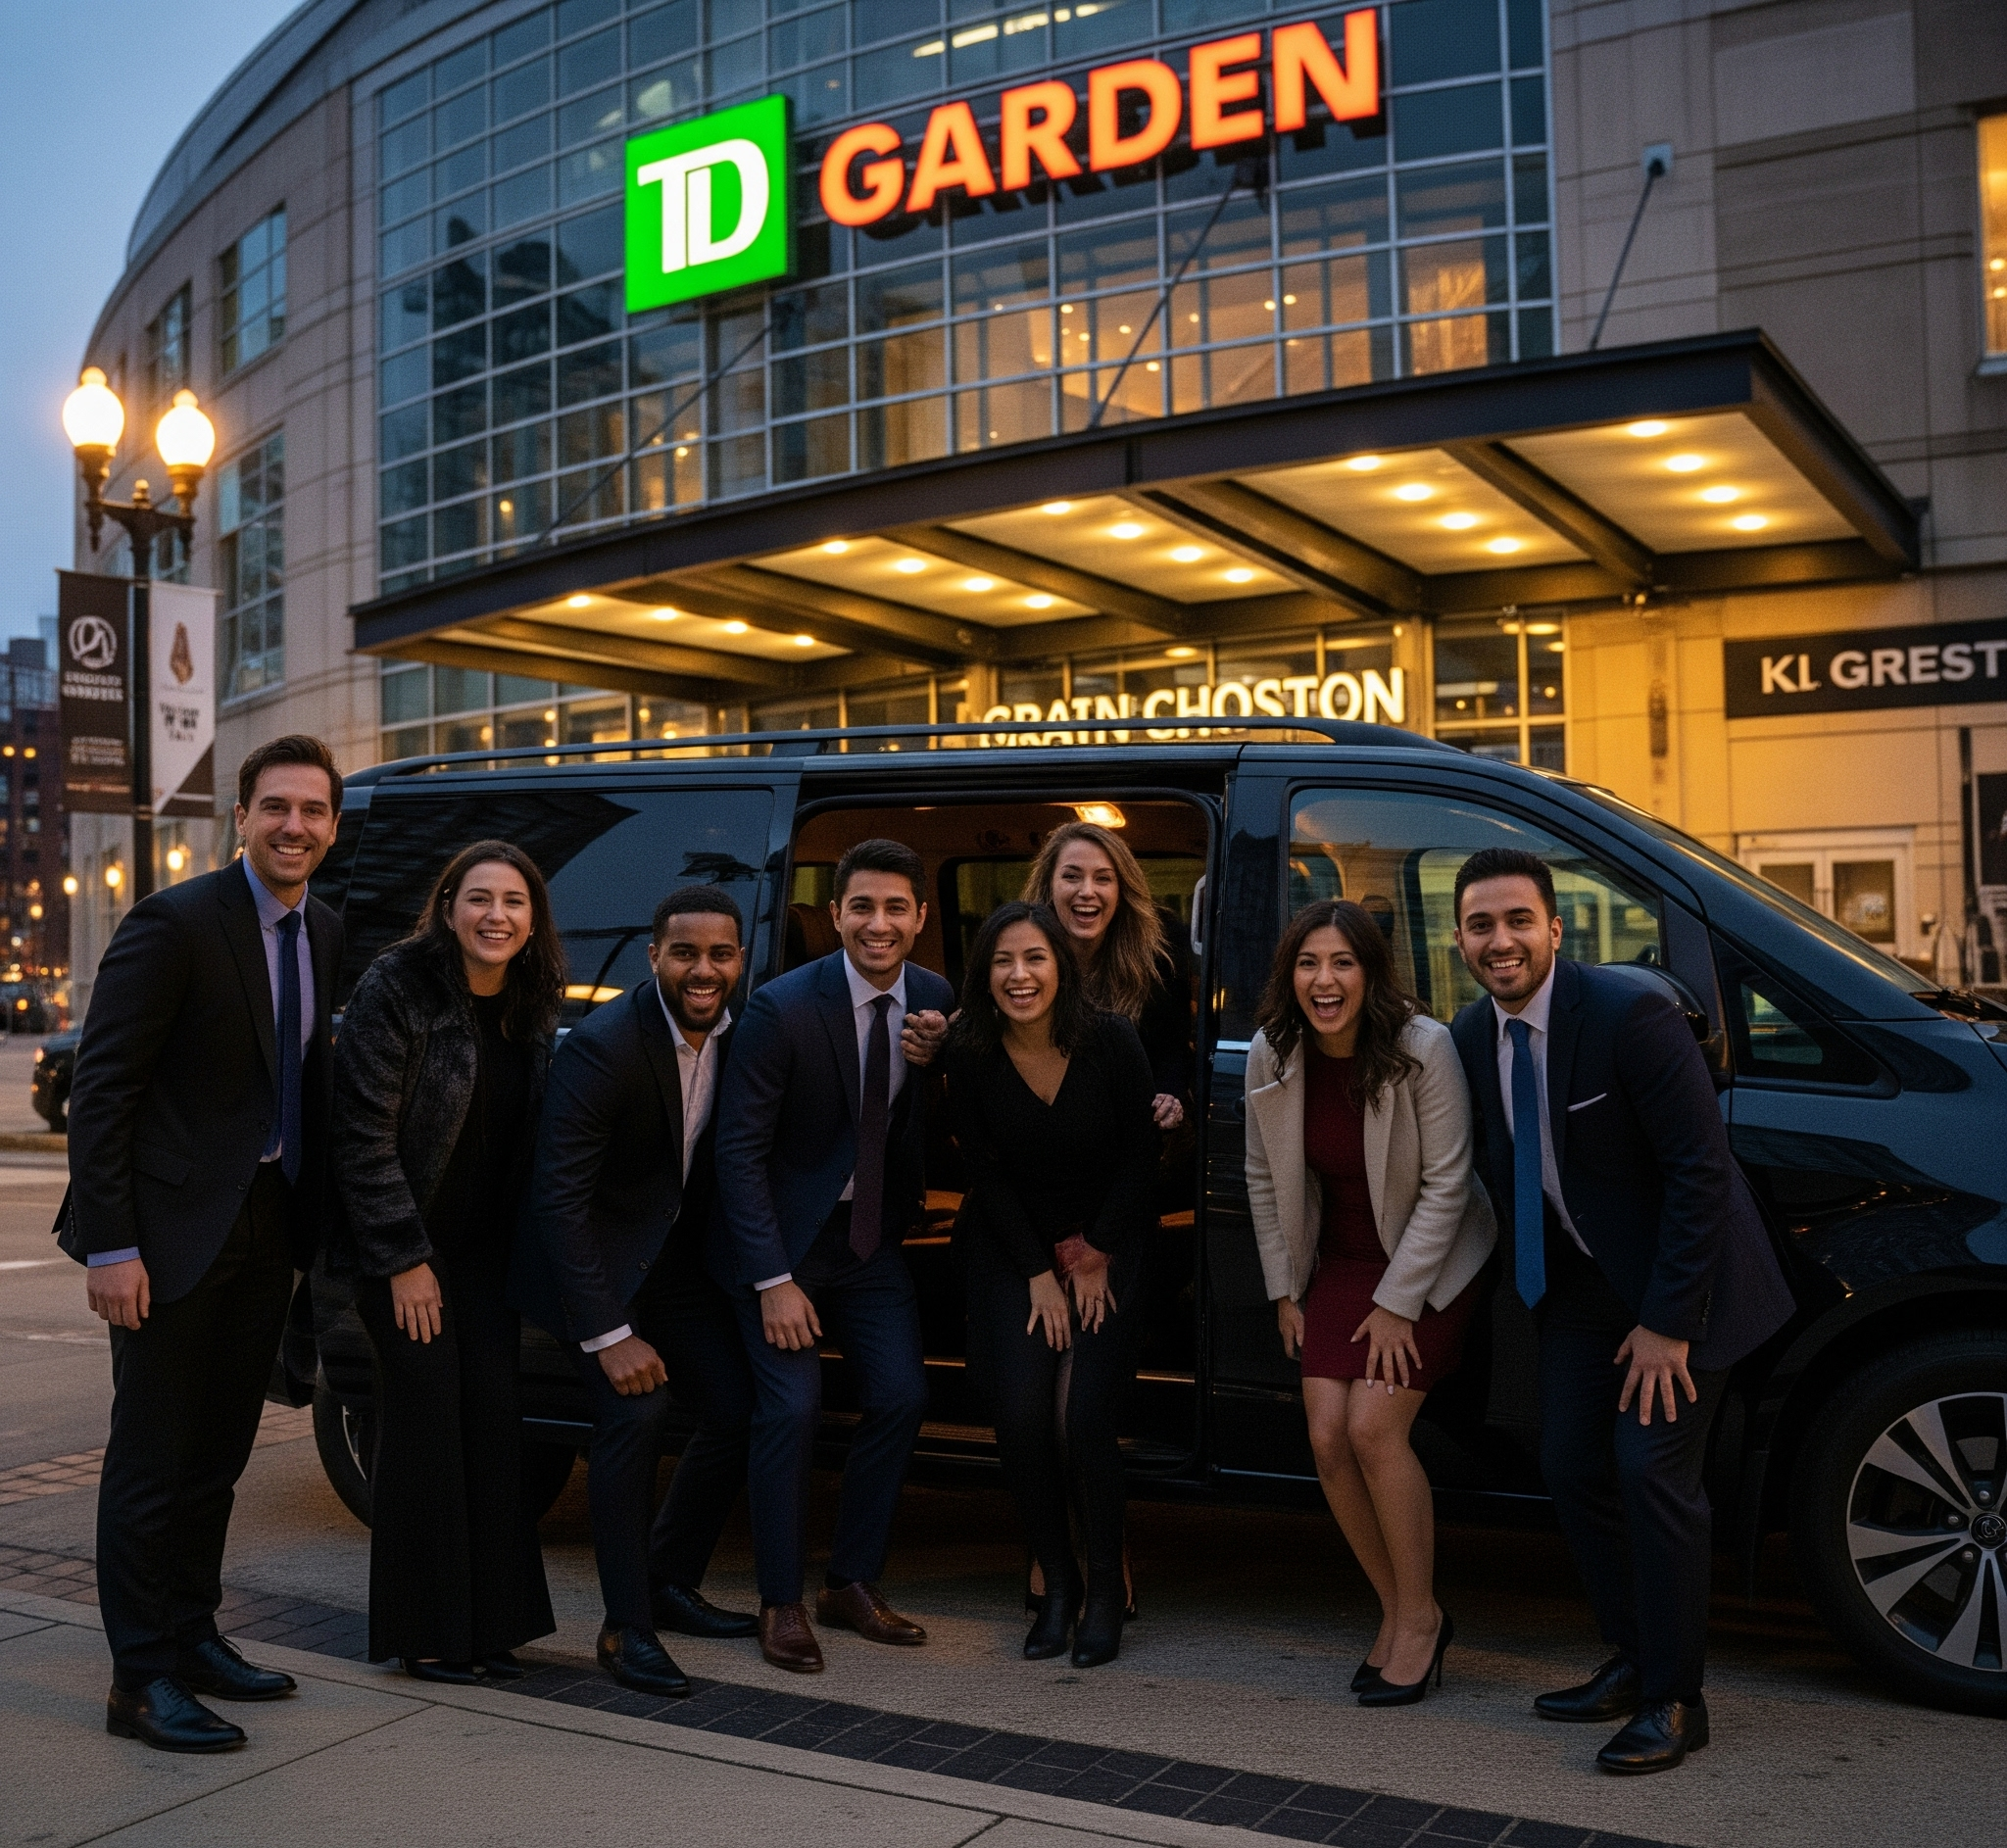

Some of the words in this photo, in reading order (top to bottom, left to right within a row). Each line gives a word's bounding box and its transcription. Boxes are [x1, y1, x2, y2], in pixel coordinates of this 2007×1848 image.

[637, 138, 769, 274] TD
[819, 8, 1380, 227] GARDEN
[1829, 639, 2007, 690] GREST
[1142, 666, 1405, 741] CHOSTON
